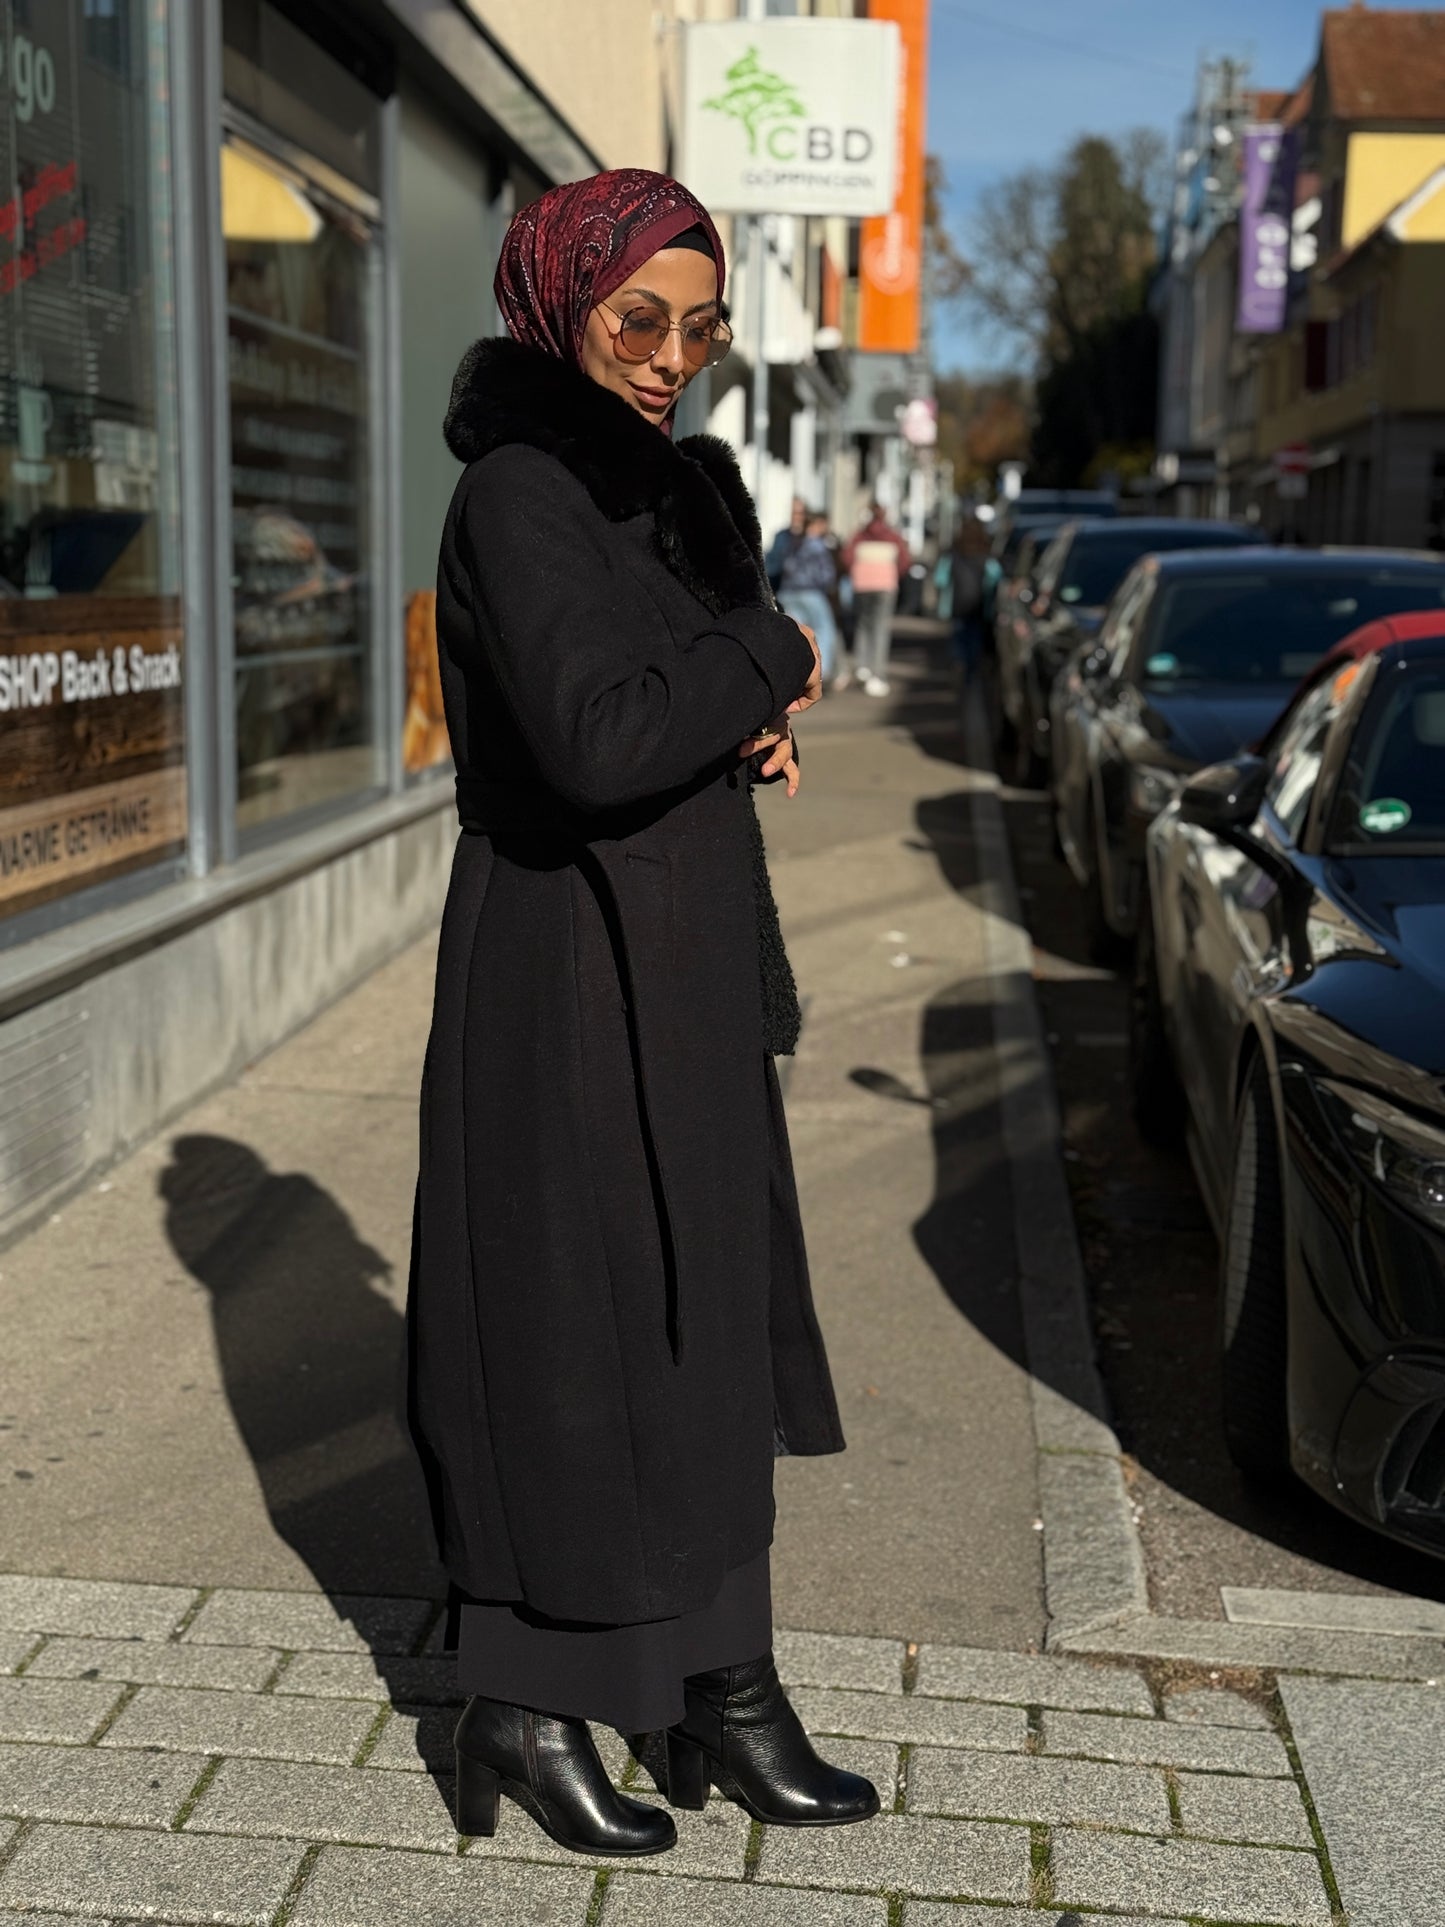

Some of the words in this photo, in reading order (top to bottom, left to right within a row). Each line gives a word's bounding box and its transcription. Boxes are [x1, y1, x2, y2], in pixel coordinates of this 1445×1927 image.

[14, 35, 55, 122] go
[766, 125, 873, 162] CBD
[0, 652, 60, 712] SHOP
[62, 649, 112, 703] Back
[112, 645, 129, 695] &
[129, 641, 182, 693] Snack
